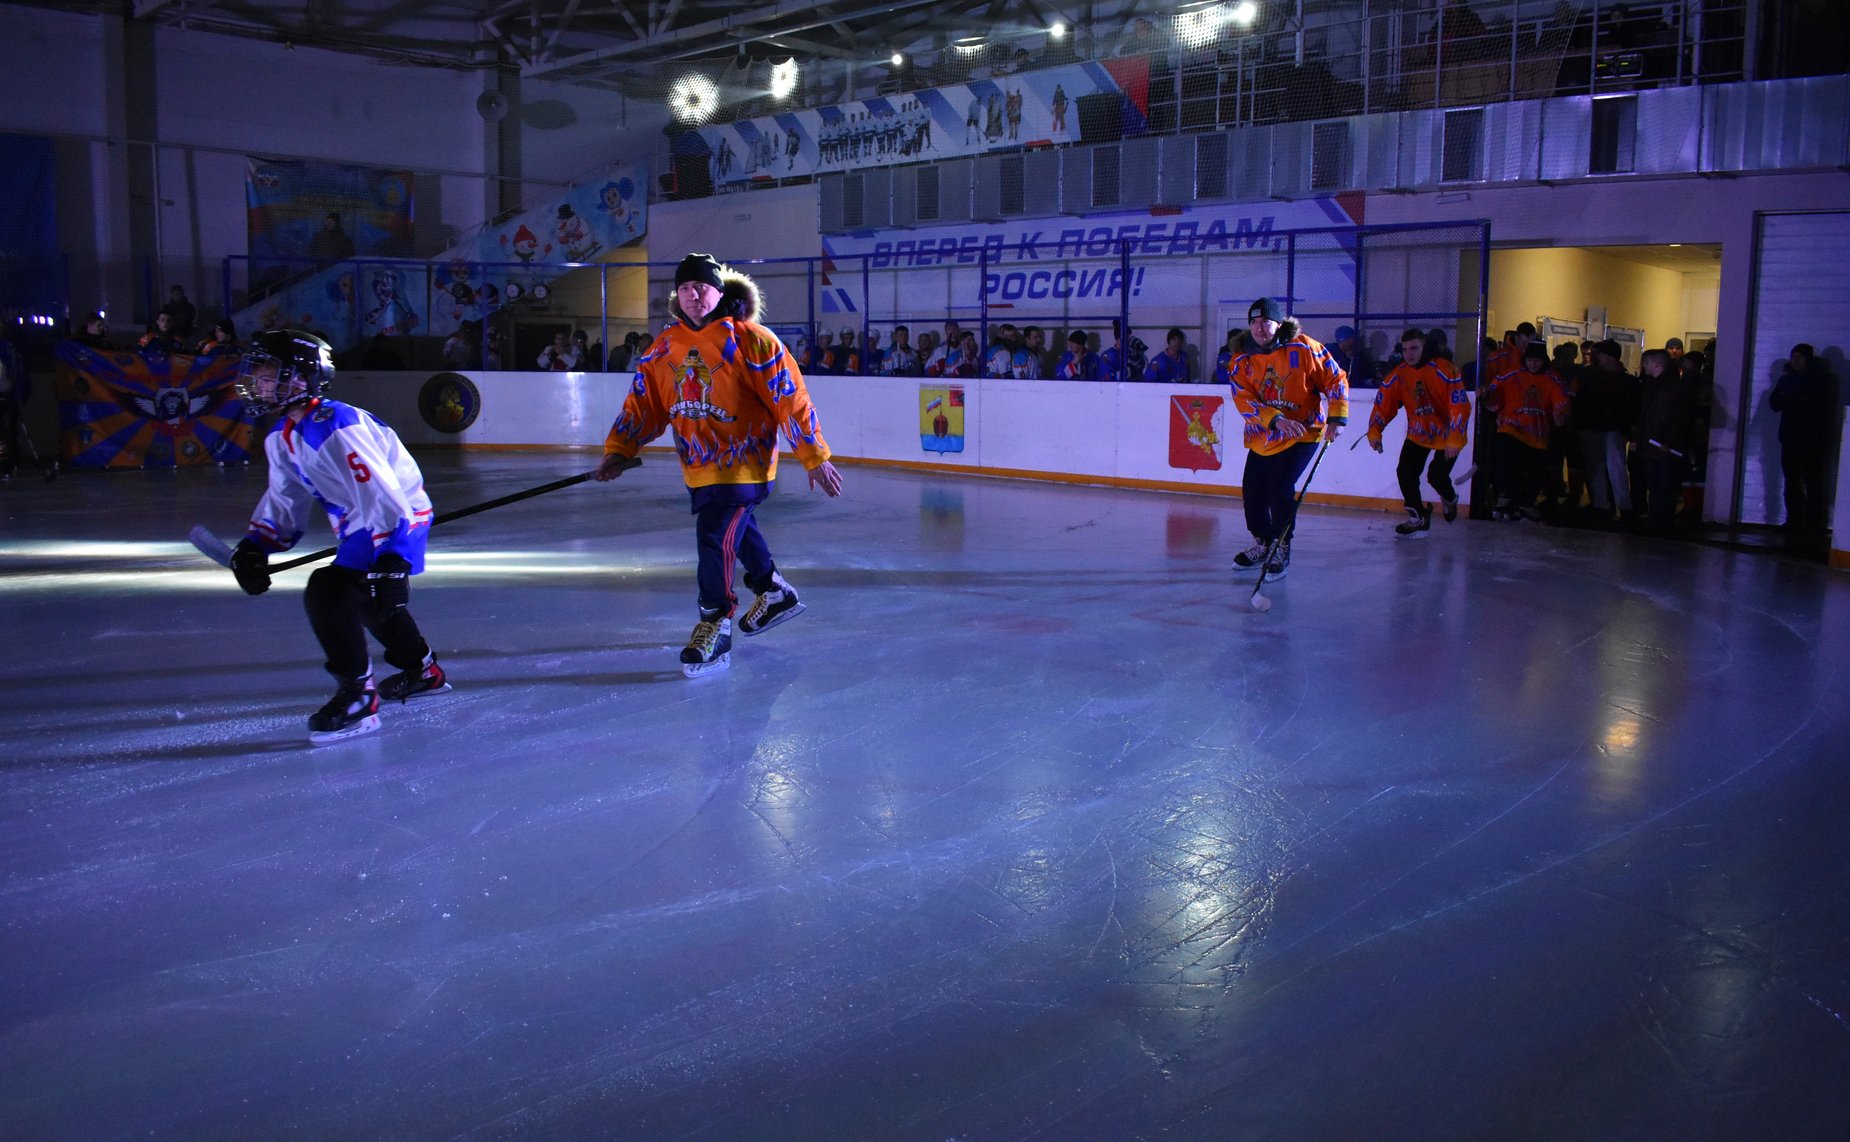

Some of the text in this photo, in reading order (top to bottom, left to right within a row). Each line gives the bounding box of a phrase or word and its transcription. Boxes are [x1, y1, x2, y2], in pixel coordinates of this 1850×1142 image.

[872, 216, 1283, 268] ВПЕРЕД К ПОБЕДАМ,
[978, 266, 1146, 301] РОССИЯ!
[766, 367, 797, 405] 73
[347, 452, 371, 483] 5
[366, 572, 406, 580] EFSI
